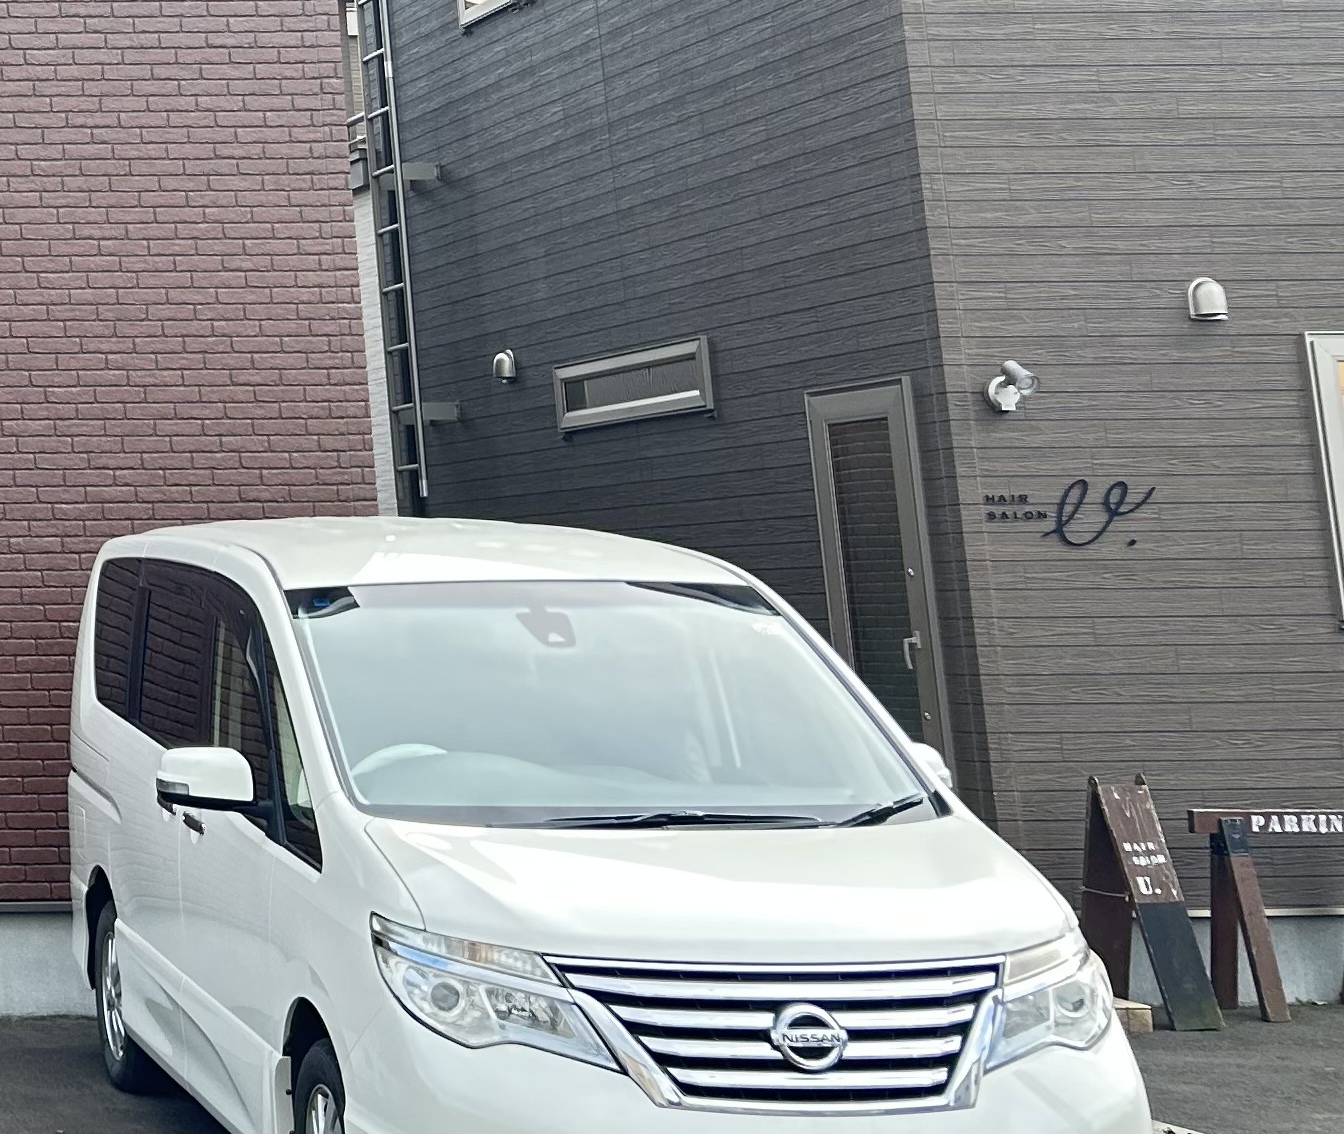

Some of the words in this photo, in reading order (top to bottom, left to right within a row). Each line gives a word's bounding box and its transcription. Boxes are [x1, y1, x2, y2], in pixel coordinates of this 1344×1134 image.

[984, 494, 1030, 504] HAIR
[986, 510, 1049, 521] SALON
[782, 1033, 841, 1043] NISSAN
